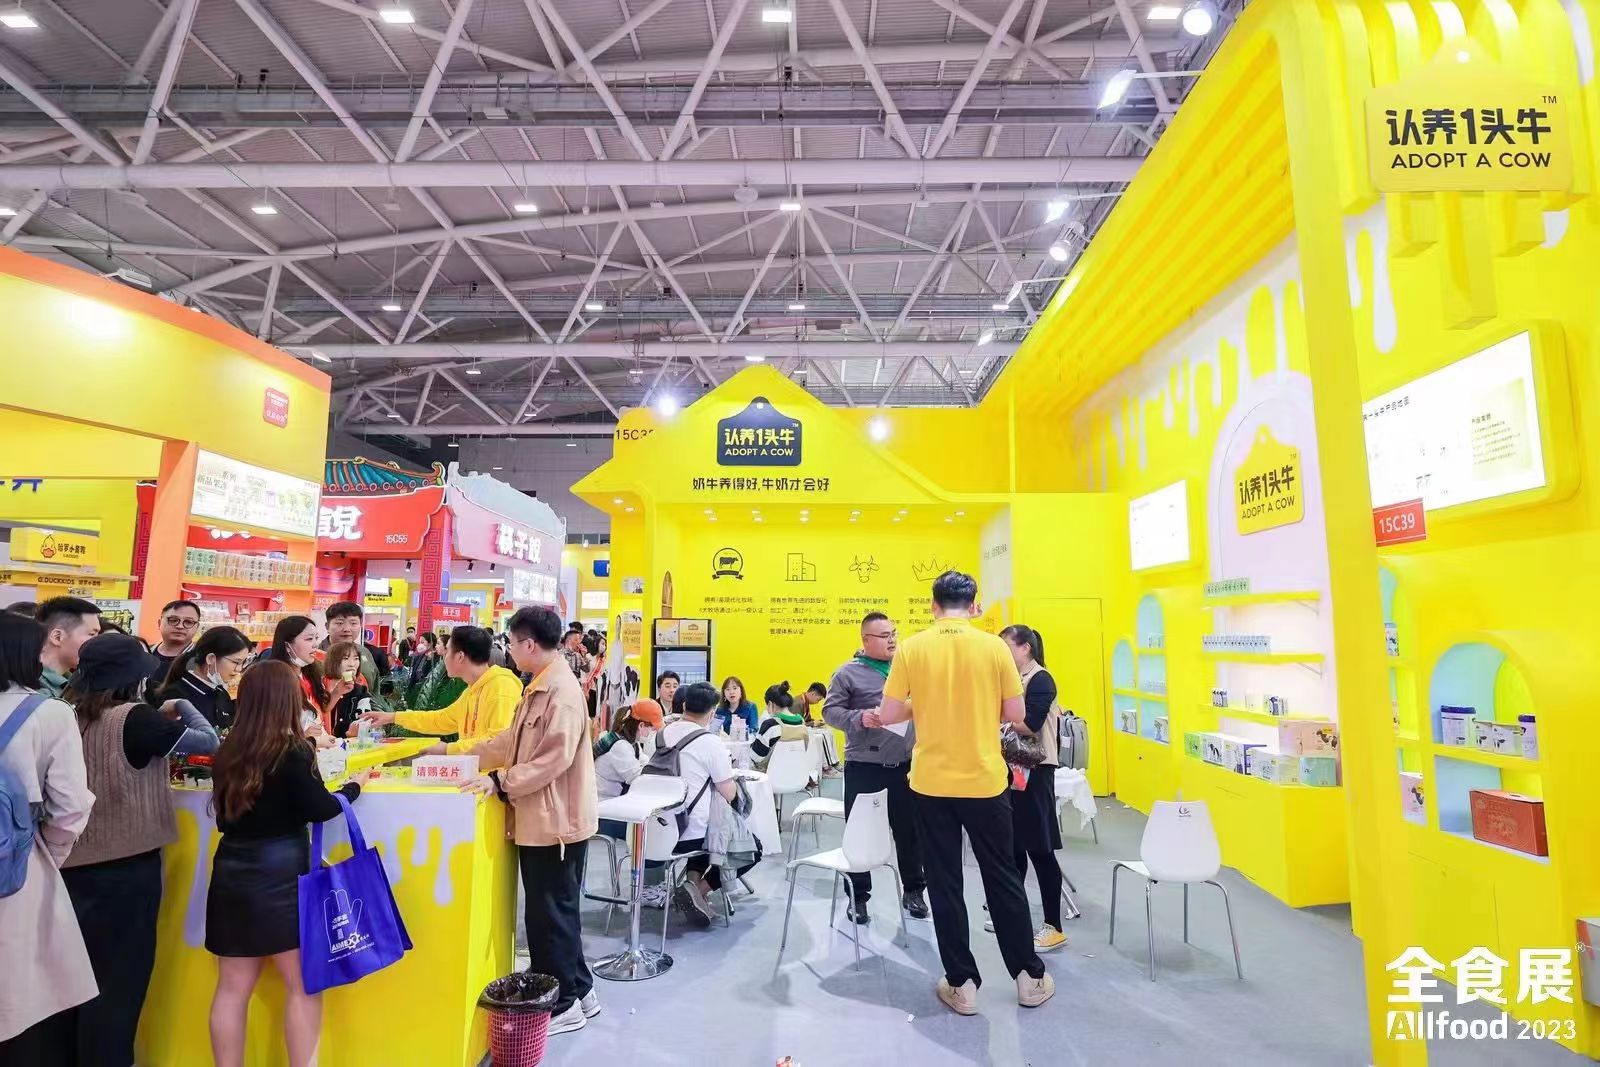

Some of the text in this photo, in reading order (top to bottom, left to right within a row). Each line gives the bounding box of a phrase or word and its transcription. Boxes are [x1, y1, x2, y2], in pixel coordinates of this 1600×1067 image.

[1542, 95, 1558, 104] TM
[1385, 108, 1551, 146] 认养1头牛
[1391, 152, 1551, 169] ADOPT A COW
[724, 428, 795, 446] 认养1头牛
[724, 448, 794, 456] ADOPT A COW
[1239, 464, 1295, 505] 认养1头牛
[1241, 495, 1295, 519] ADOPT A COW
[1378, 512, 1417, 534] 15C39
[385, 535, 408, 544] 15C55
